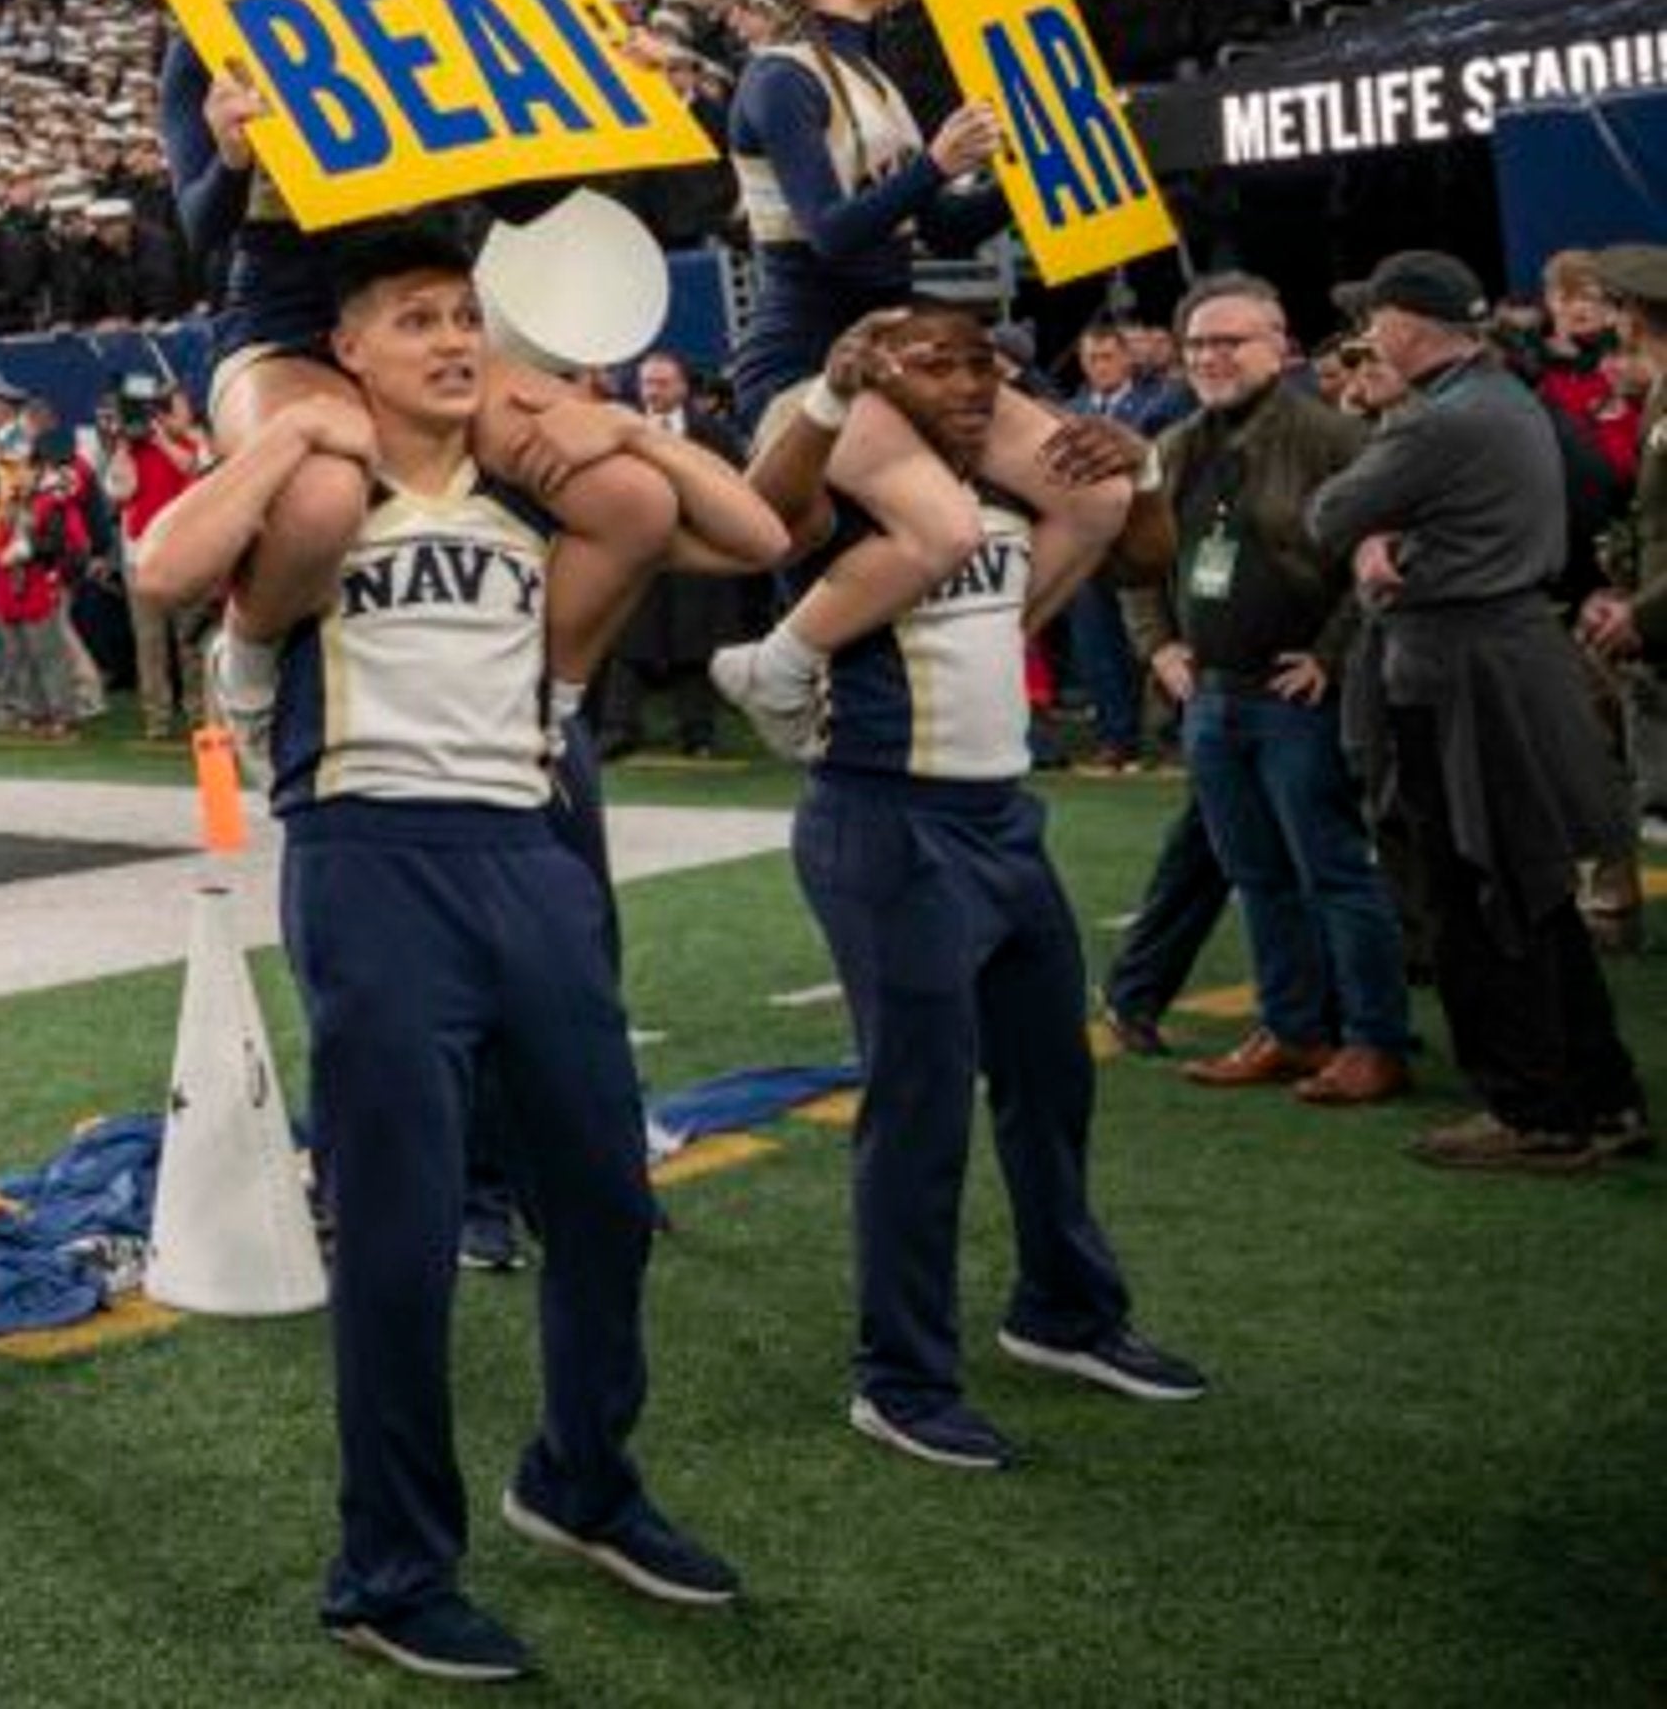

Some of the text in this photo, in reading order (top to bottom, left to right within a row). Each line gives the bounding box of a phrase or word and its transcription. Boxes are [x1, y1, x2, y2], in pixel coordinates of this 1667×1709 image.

[982, 4, 1148, 228] AR
[1222, 65, 1449, 166] METLIFE
[342, 545, 542, 617] NAVY
